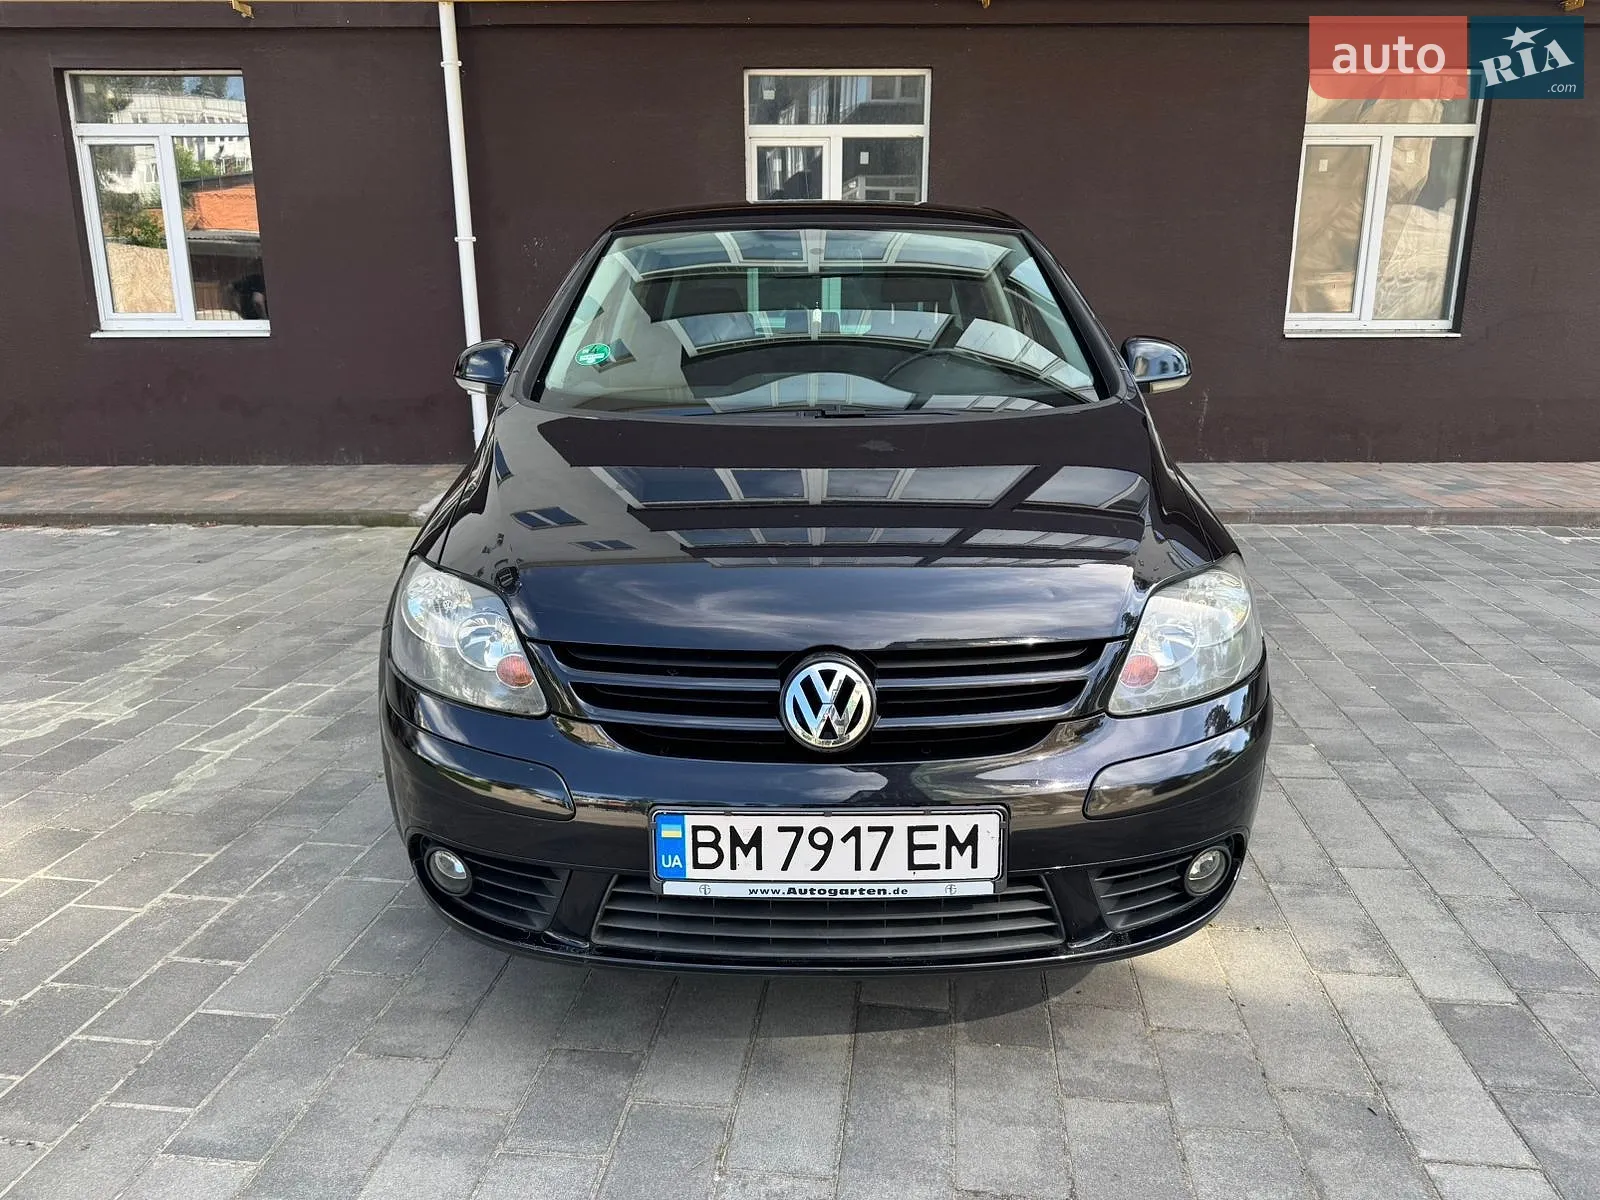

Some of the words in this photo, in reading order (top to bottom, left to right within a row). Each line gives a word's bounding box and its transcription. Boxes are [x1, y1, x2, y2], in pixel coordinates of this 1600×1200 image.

[691, 825, 763, 871] BM
[777, 825, 894, 871] 7917
[907, 824, 979, 871] EM
[661, 854, 683, 868] UA
[748, 887, 909, 896] www.Autogarten.de
